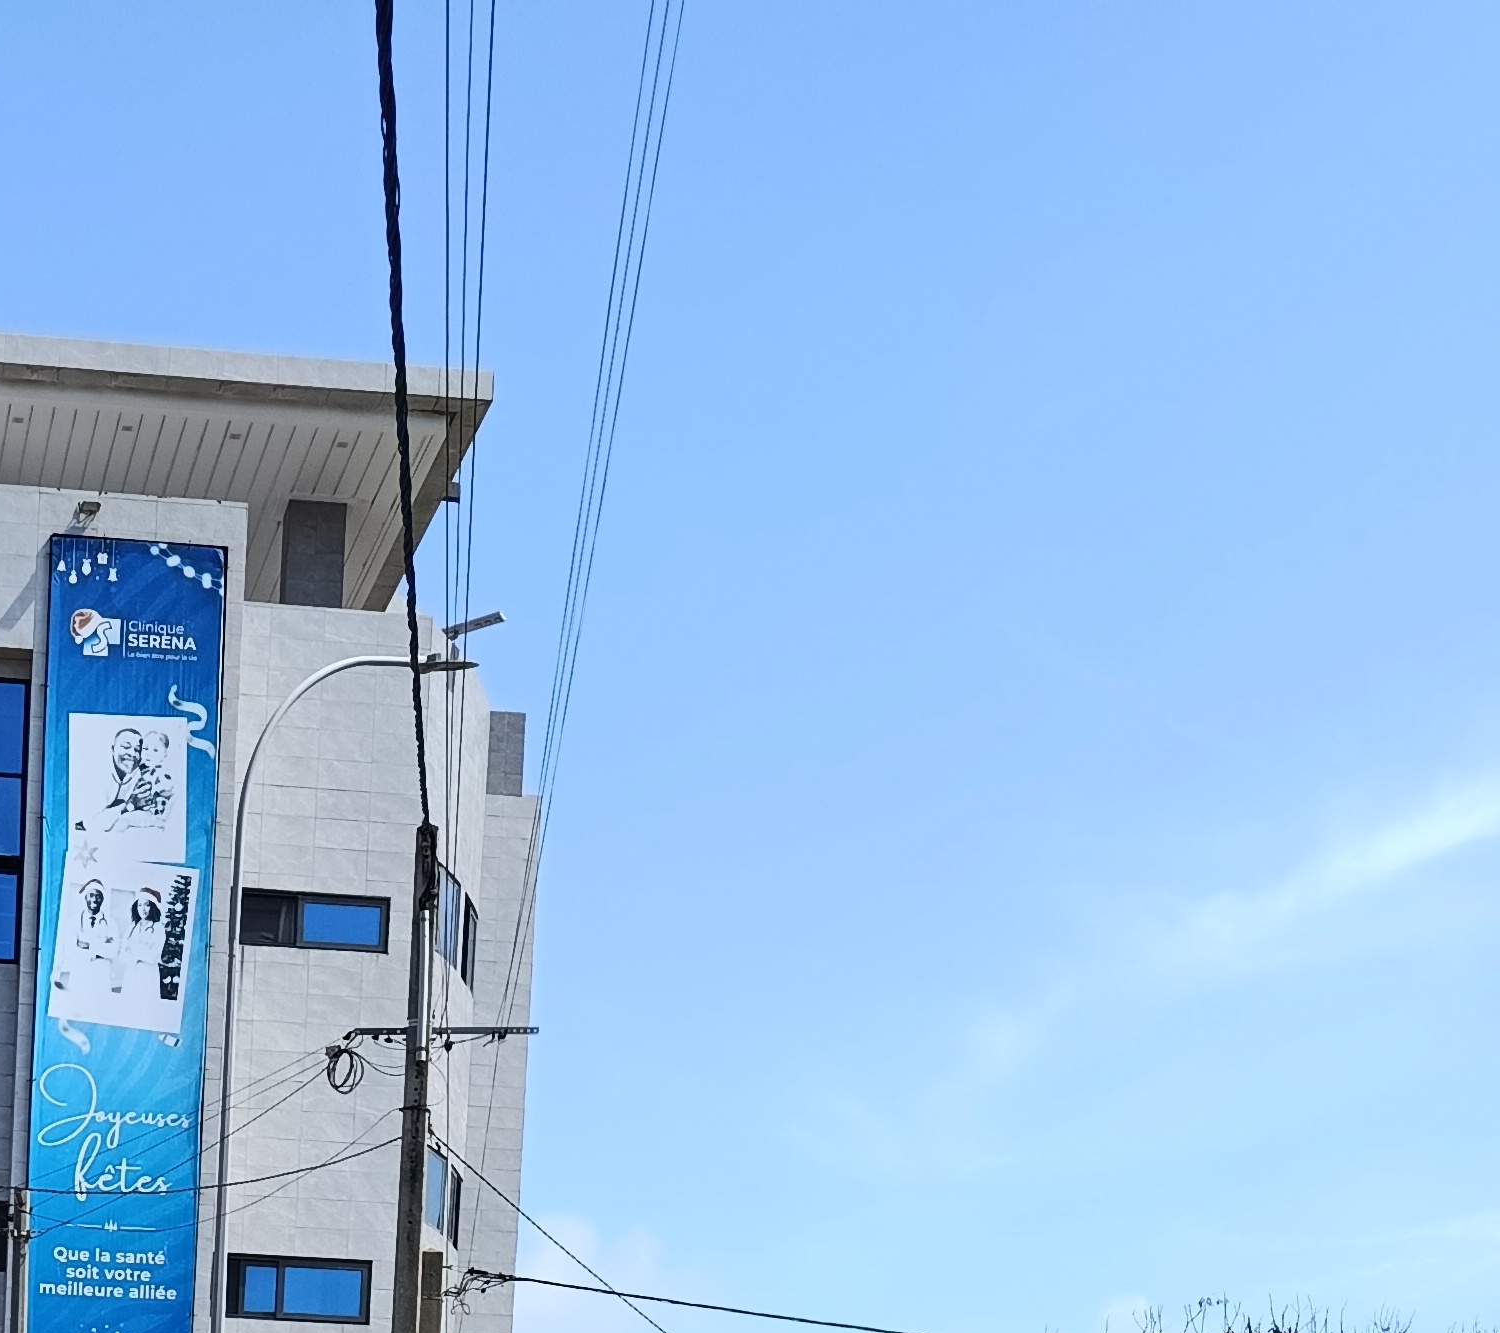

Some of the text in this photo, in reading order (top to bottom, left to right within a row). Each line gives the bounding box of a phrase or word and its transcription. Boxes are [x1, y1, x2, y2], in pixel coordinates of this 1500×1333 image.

[128, 620, 185, 636] Clinique
[127, 633, 197, 651] SERENA
[37, 1063, 192, 1149] Joyeuses
[74, 1132, 173, 1202] fêtes
[53, 1246, 166, 1265] Que la santé
[65, 1264, 152, 1282] soit votre
[39, 1280, 178, 1300] meilleure alliée
